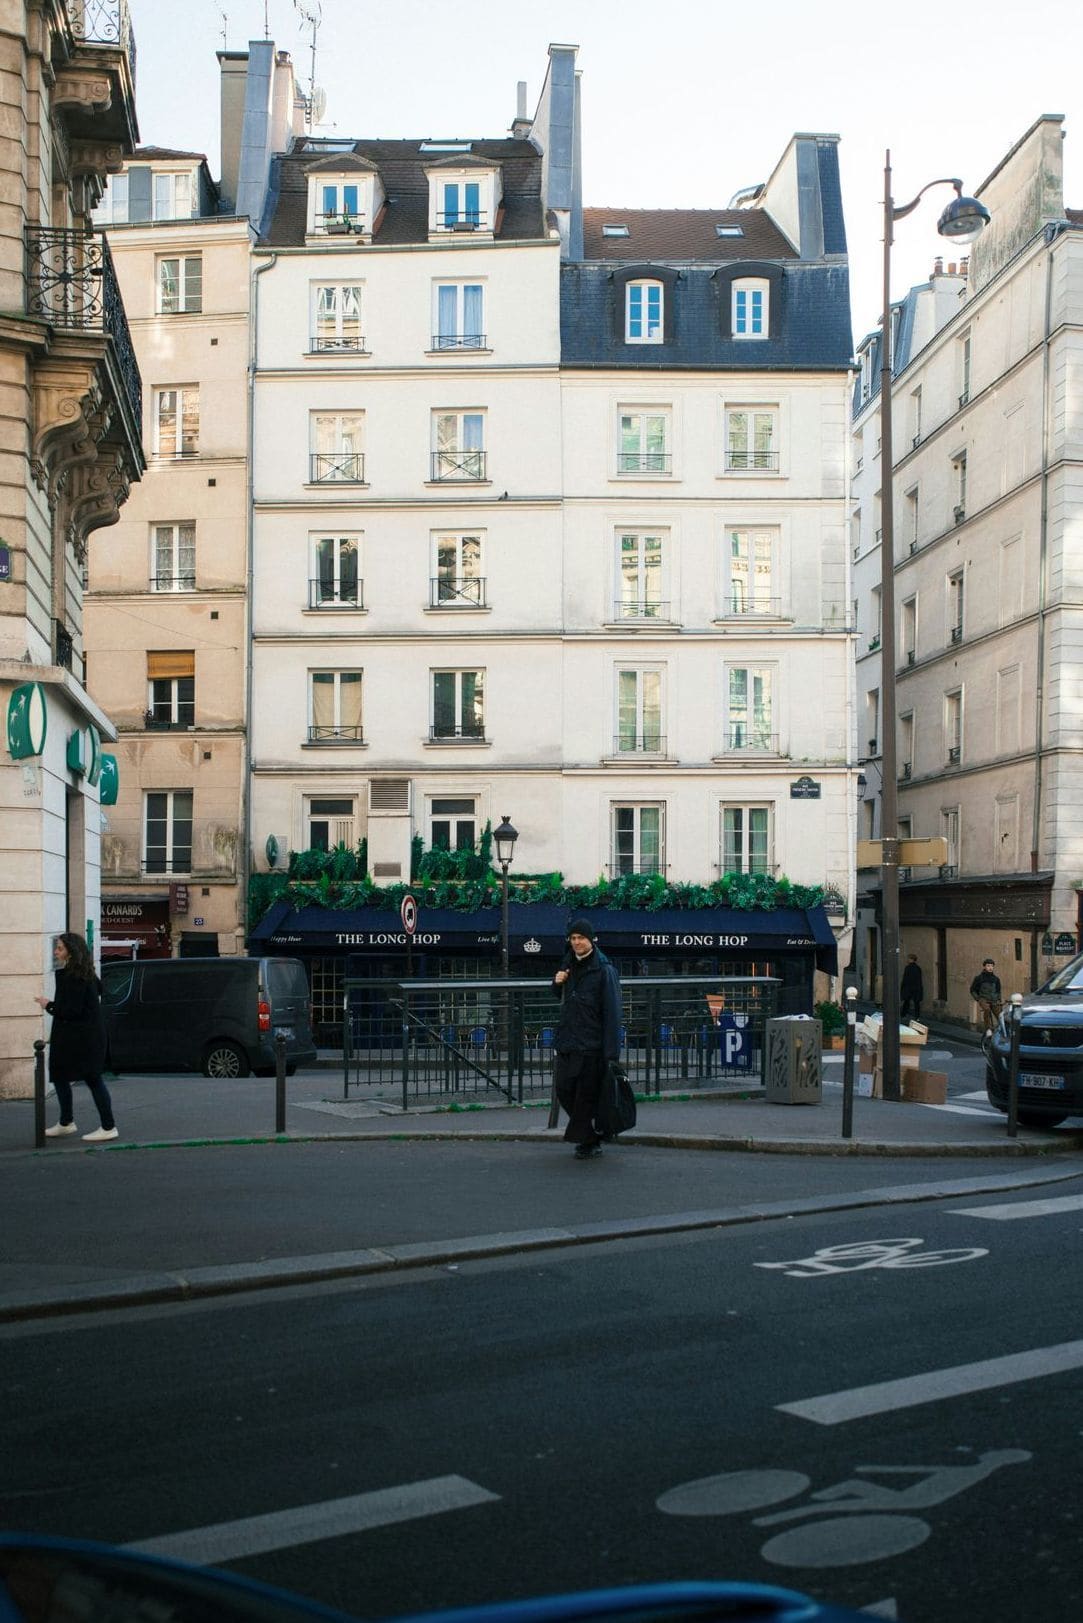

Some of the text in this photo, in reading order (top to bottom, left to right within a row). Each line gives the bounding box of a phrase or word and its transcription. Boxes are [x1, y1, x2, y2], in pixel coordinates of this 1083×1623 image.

[106, 903, 143, 916] CANARDS
[335, 934, 441, 944] THE LONG HOP
[641, 934, 748, 946] THE LONG HOP
[726, 1029, 742, 1062] P
